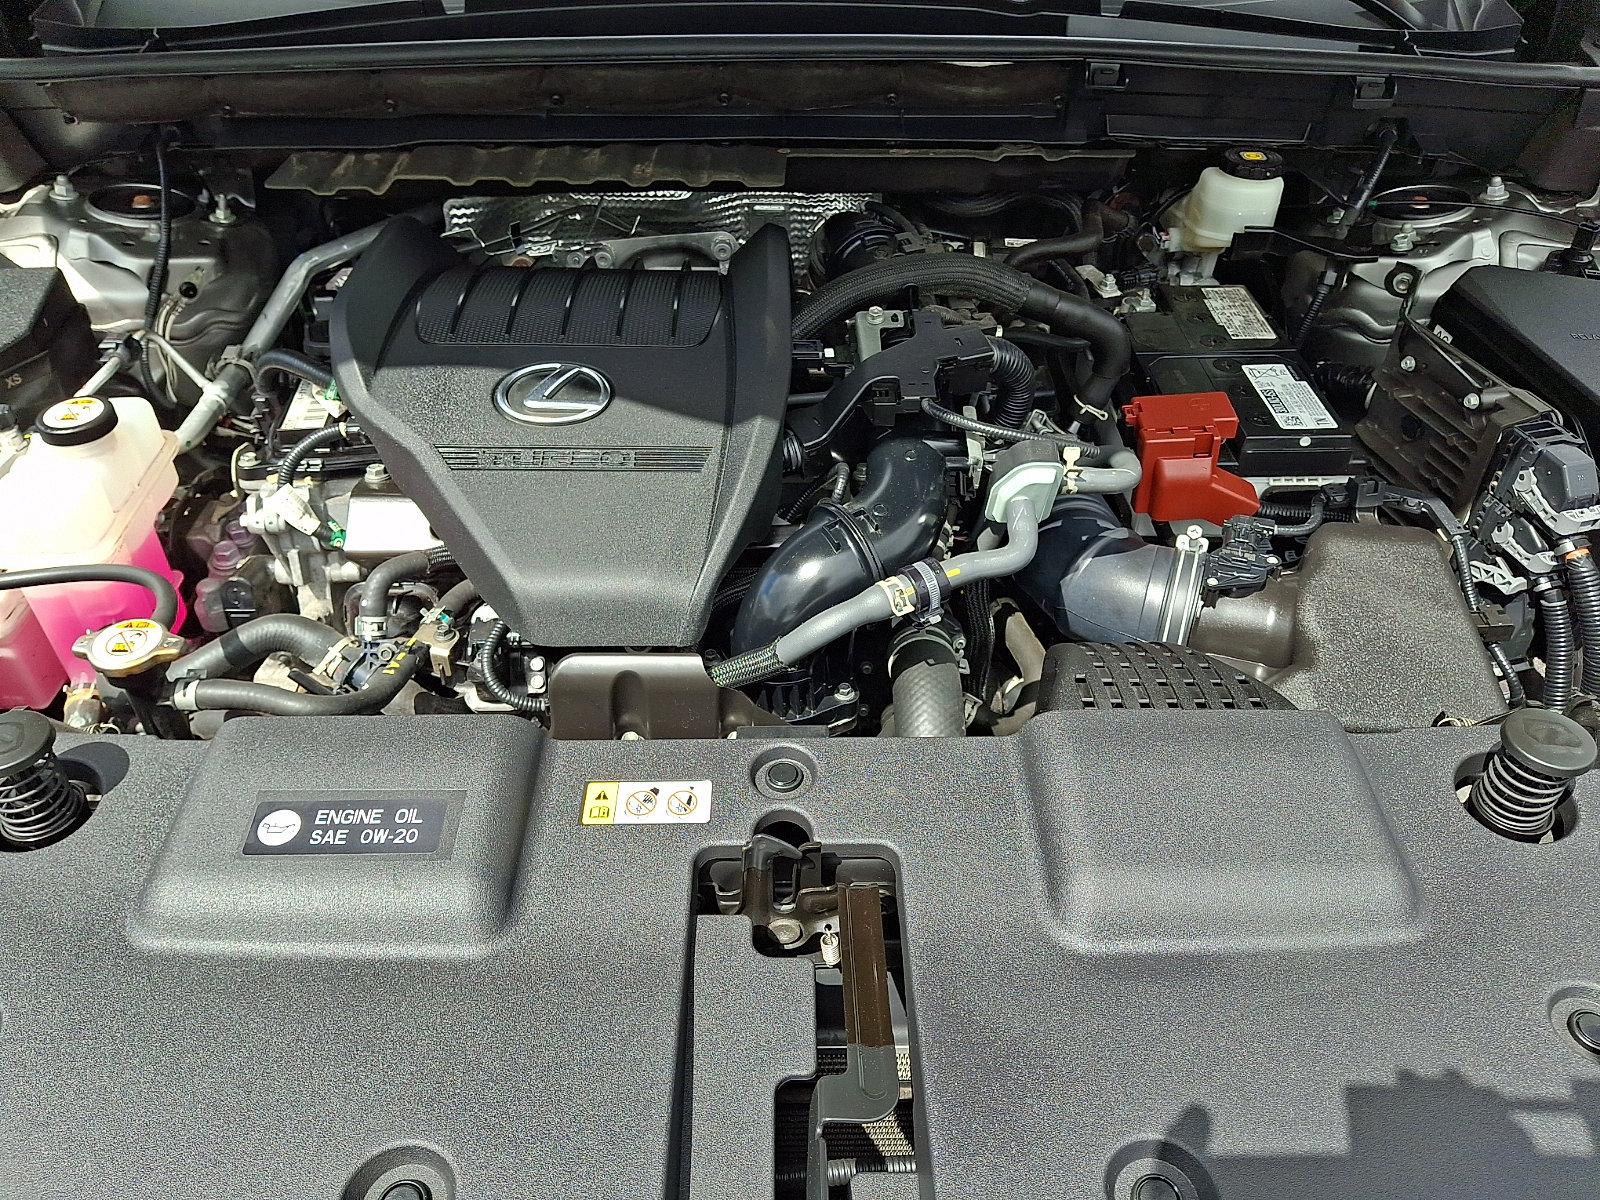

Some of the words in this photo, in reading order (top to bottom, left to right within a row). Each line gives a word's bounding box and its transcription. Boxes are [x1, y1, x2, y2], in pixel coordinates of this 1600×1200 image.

[314, 808, 384, 825] ENGINE
[394, 808, 423, 824] OIL
[309, 829, 349, 845] SAE
[360, 828, 419, 844] 0W-20
